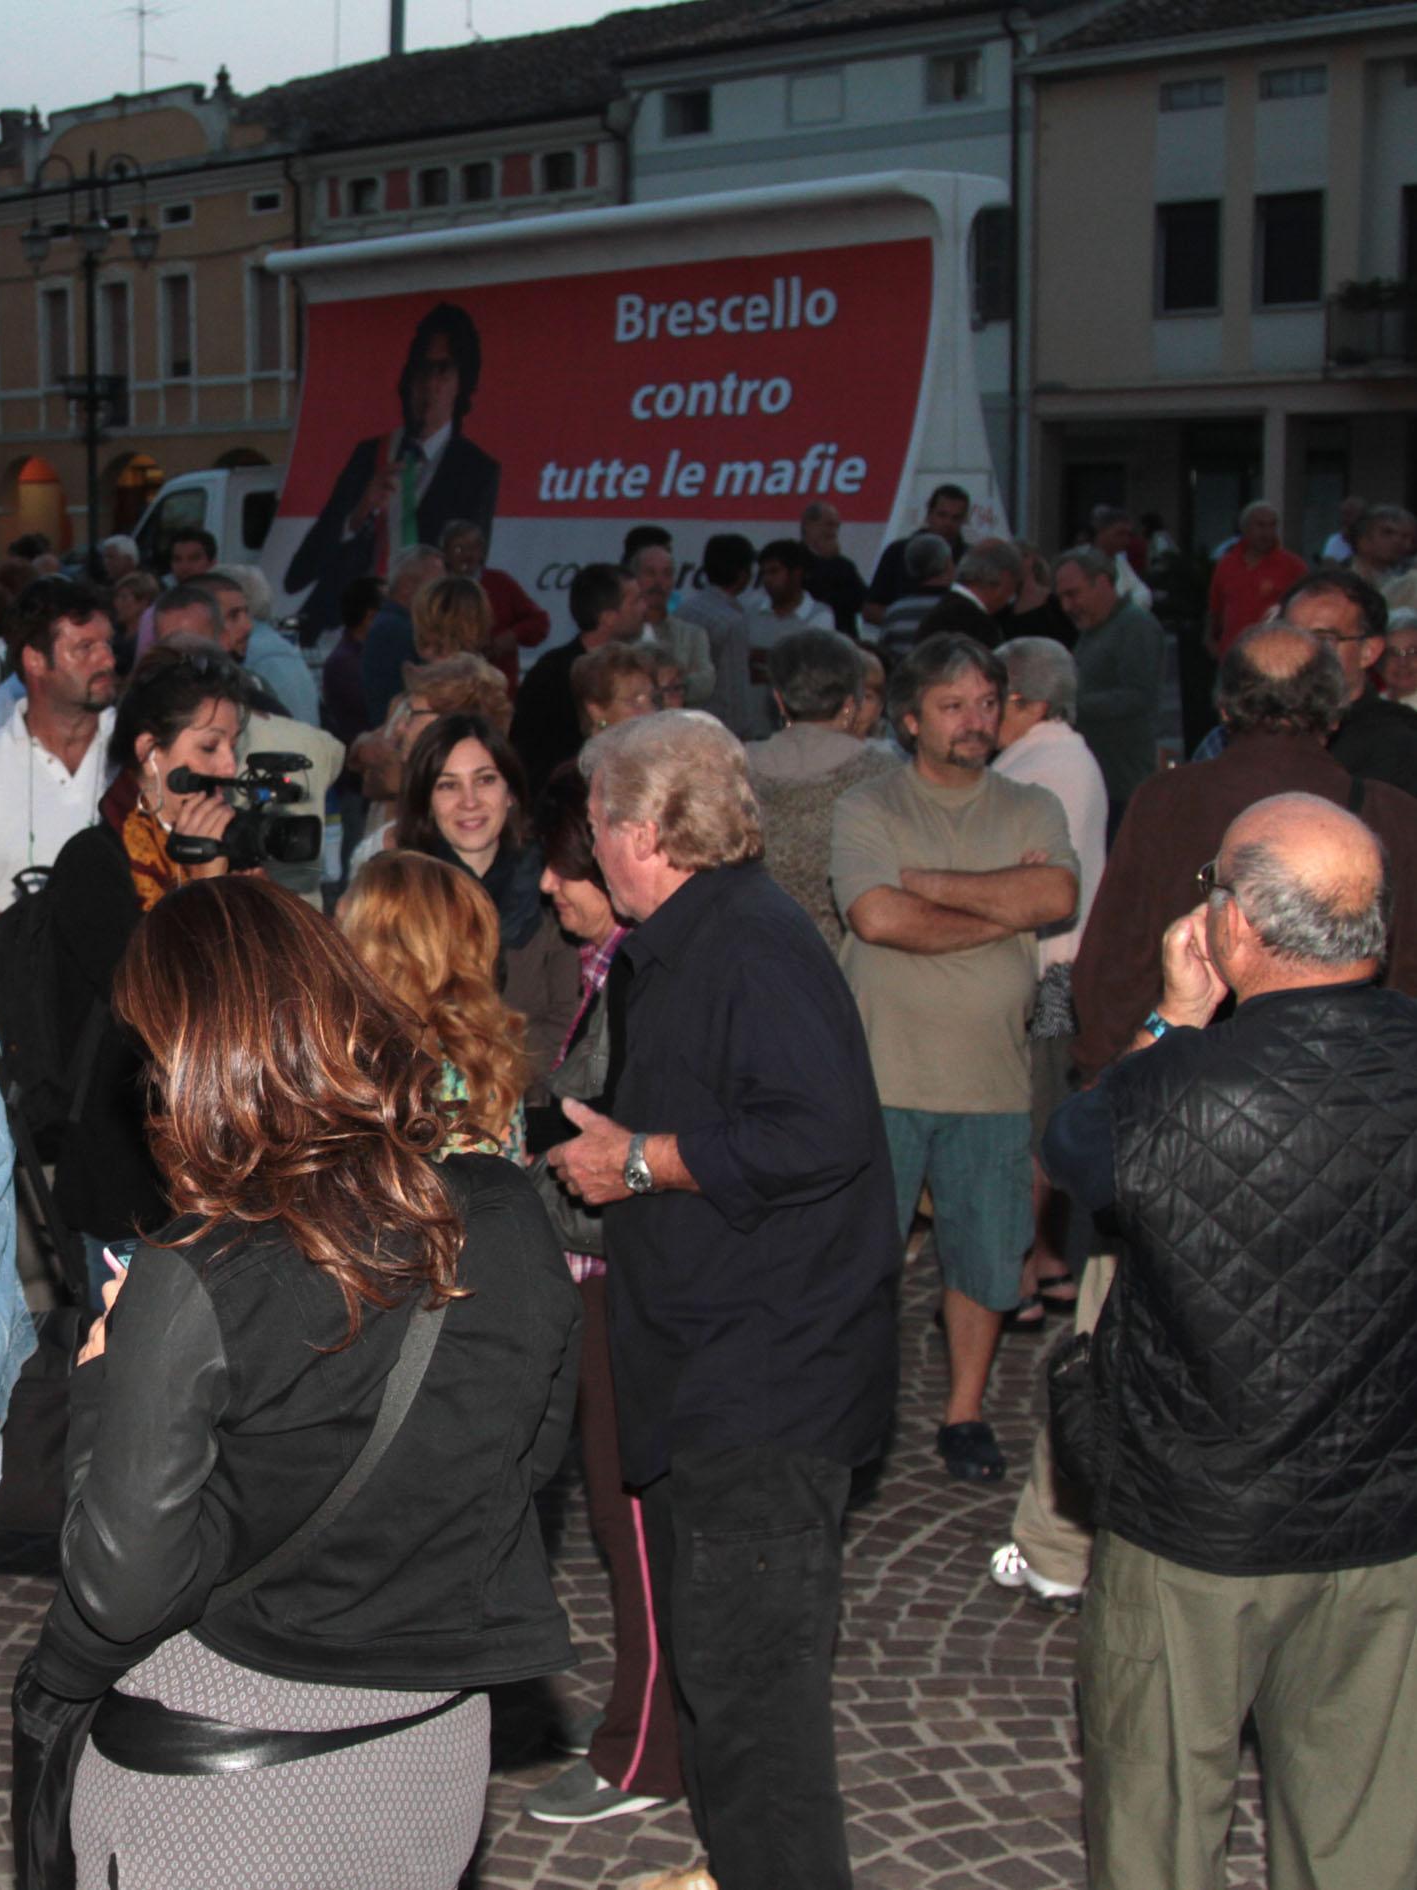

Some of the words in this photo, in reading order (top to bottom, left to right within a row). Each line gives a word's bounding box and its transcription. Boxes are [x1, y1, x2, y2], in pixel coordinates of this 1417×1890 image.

[614, 275, 838, 343] Brescello
[631, 371, 792, 420] contro
[539, 459, 650, 501] tutte
[659, 449, 706, 497] le
[713, 442, 867, 497] mafie
